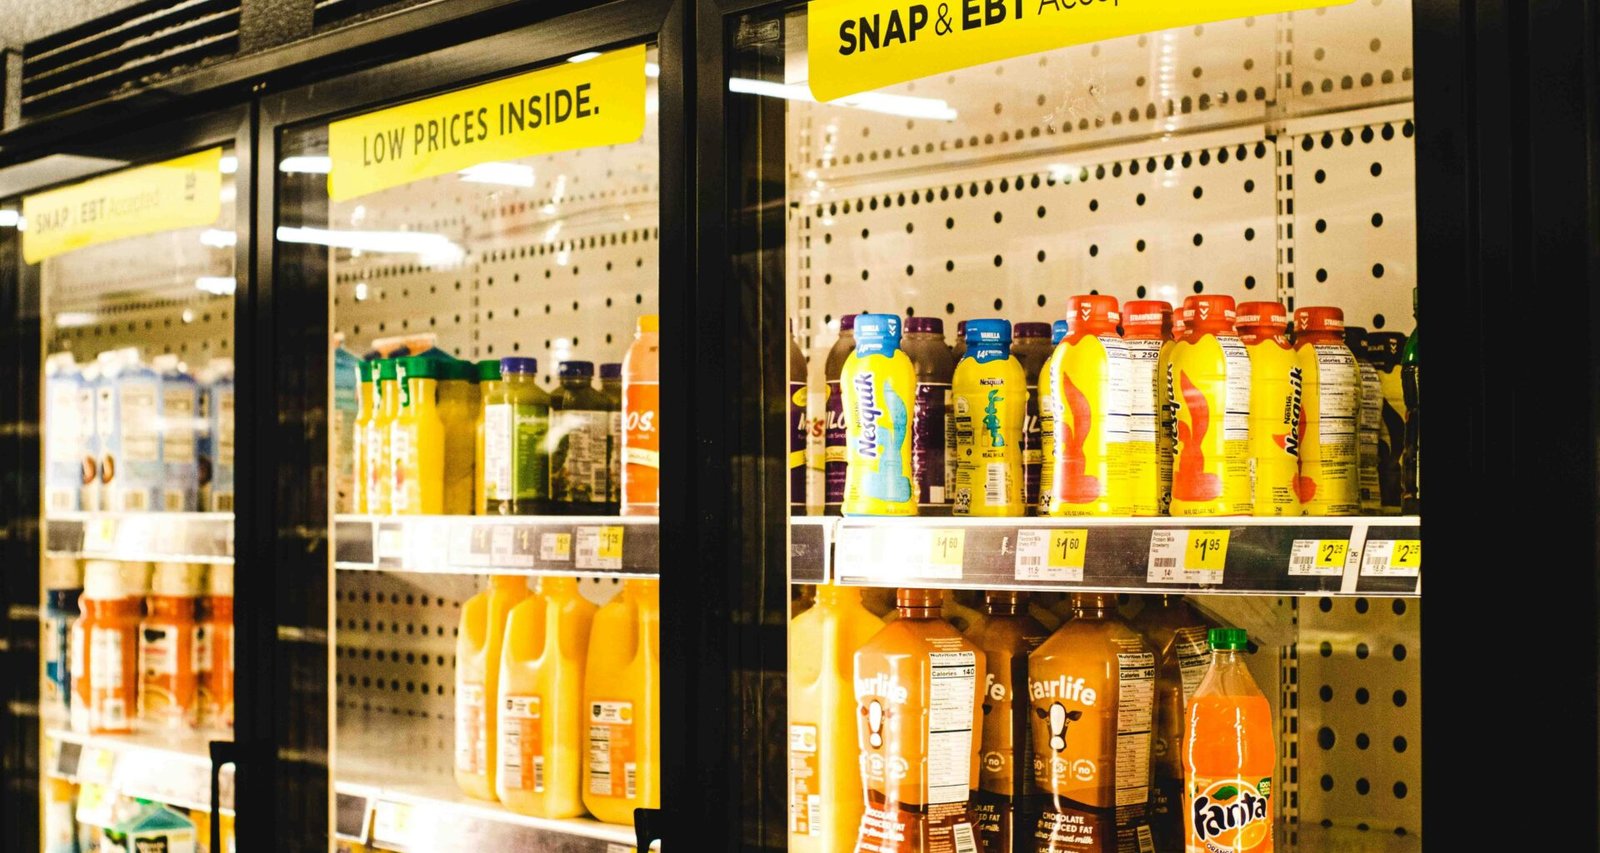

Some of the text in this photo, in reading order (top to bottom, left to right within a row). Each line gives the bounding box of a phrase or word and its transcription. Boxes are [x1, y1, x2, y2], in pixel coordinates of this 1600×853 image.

[839, 4, 929, 56] SNAP
[935, 2, 953, 36] &
[363, 83, 600, 167] LOW PRICES INSIDE.
[81, 199, 105, 224] EBT
[1142, 351, 1159, 359] 250
[854, 373, 881, 458] Nesquik
[1285, 367, 1303, 457] Nesquik
[962, 668, 975, 676] 140
[988, 758, 1000, 767] no
[1078, 766, 1091, 775] no
[1194, 792, 1267, 841] Fanta
[1079, 825, 1094, 834] FAT
